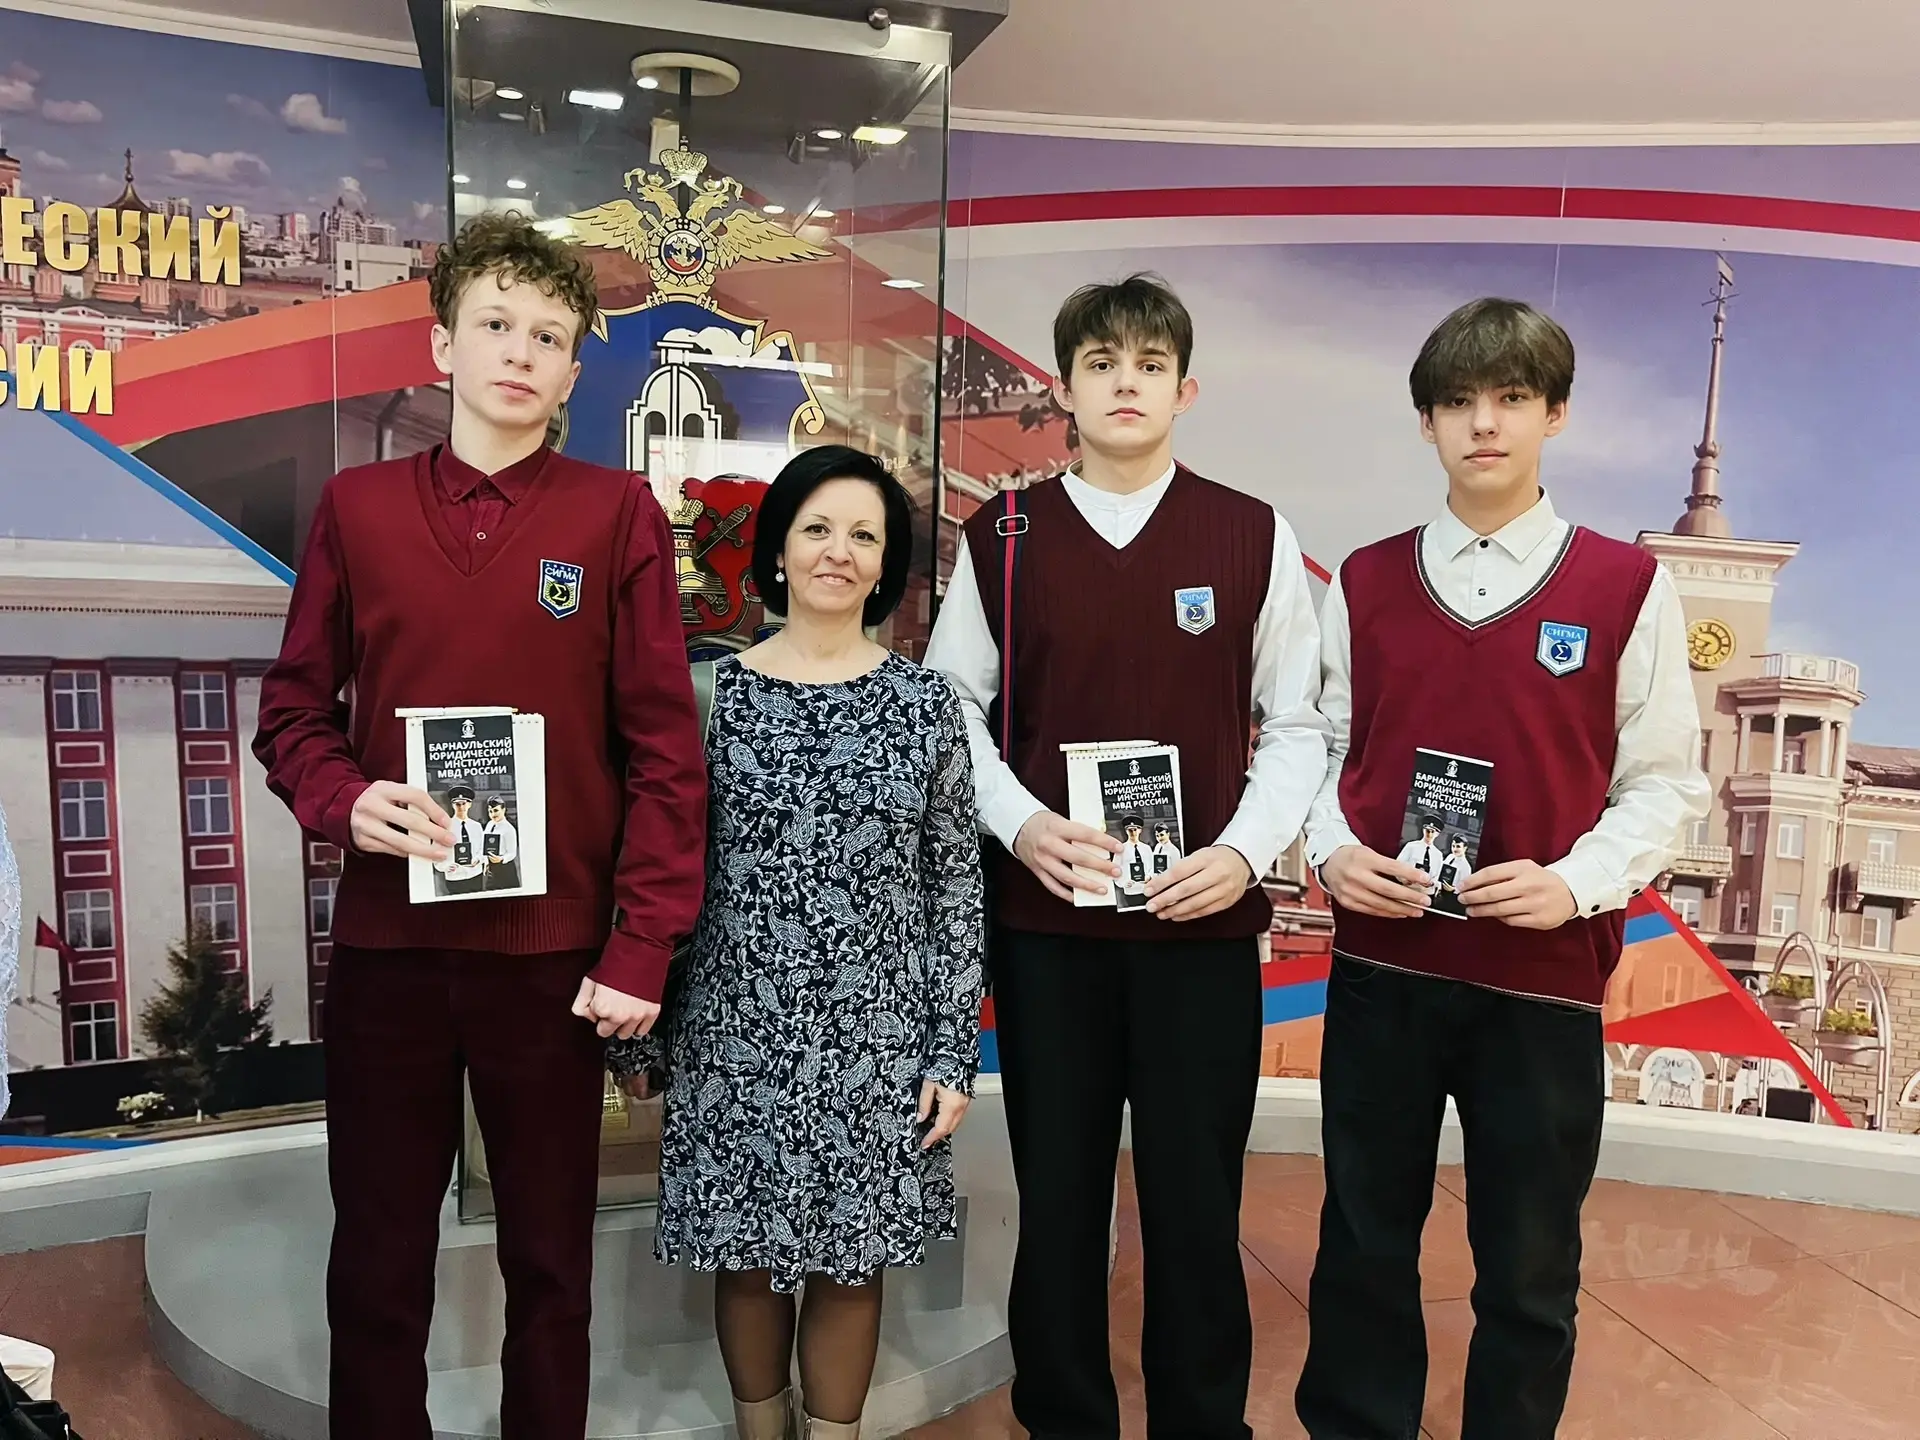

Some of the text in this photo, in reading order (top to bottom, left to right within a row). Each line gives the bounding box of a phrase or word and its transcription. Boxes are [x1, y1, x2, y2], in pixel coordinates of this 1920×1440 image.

[1, 196, 242, 286] ЕСКИЙ
[0, 343, 113, 415] ИИ
[1546, 627, 1581, 640] СИГМА
[429, 737, 512, 752] БАРНАУЛЬСКИЙ
[429, 747, 513, 761] ЮРИДИЧЕСКИЙ
[444, 757, 499, 769] ИНСТИТУТ
[437, 765, 507, 779] МВД РОССИИ
[1104, 773, 1171, 788] БАРНАУЛЬСКИЙ
[1416, 772, 1487, 794] БАРНАУЛЬСКИЙ
[1104, 781, 1172, 796] ЮРИДИЧЕСКИЙ
[1414, 780, 1486, 802] ЮРИДИЧЕСКИЙ
[1112, 797, 1169, 810] МВД РОССИИ
[1117, 791, 1161, 802] ИНСТИТУТ
[1425, 790, 1472, 807] ИНСТИТУТ
[1417, 796, 1477, 817] МВД РОССИИ
